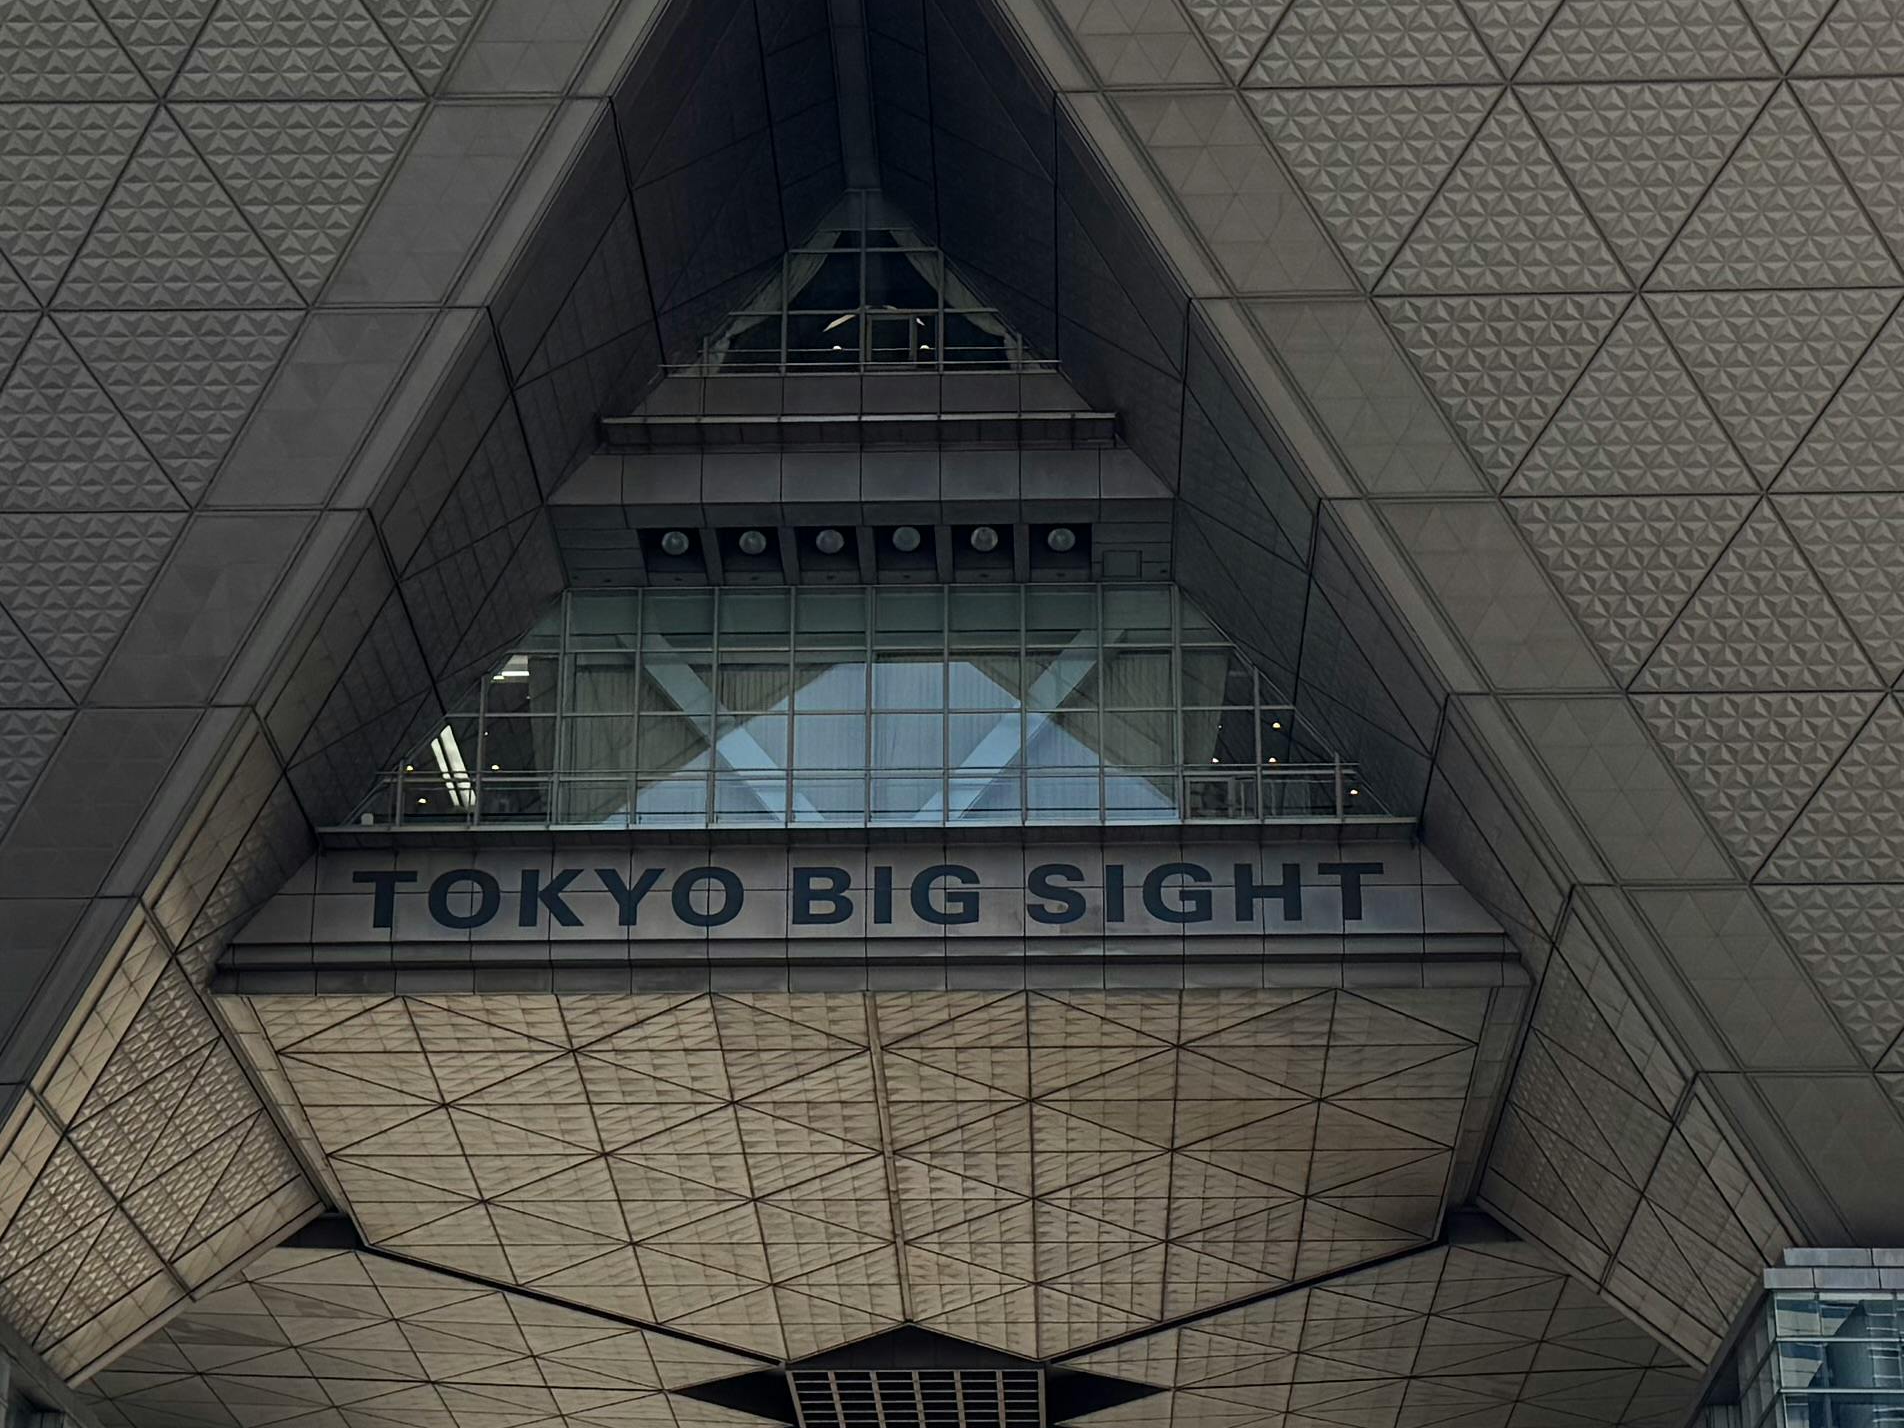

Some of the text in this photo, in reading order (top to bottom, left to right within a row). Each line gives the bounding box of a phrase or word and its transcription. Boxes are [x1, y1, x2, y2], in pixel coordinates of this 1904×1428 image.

[353, 861, 1386, 929] TOKYO BIG SIGHT
